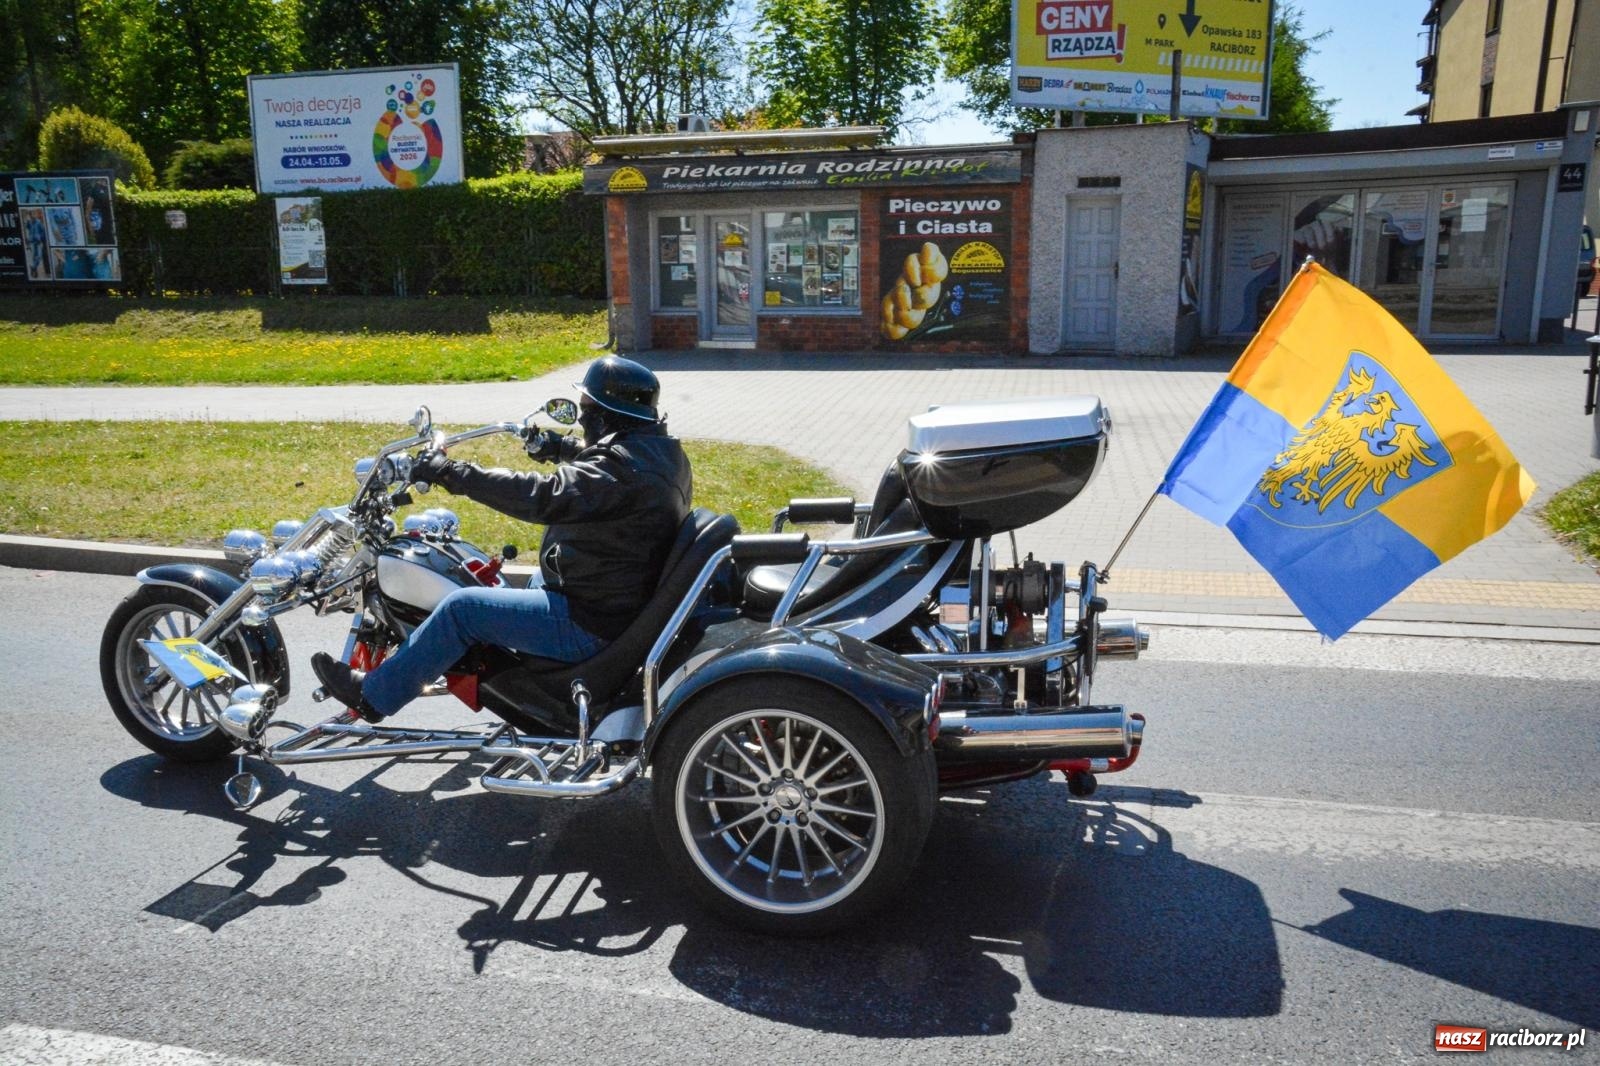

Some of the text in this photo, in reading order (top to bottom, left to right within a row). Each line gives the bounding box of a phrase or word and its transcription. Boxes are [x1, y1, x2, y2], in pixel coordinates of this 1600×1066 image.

[1041, 5, 1109, 30] CENY
[1202, 25, 1262, 39] Opawska 183
[1154, 39, 1175, 48] PARK
[263, 96, 362, 116] Twoja decyzja
[275, 117, 351, 127] NASZA REALIZACJA
[289, 156, 343, 167] 24.04.-13.05.
[662, 162, 806, 178] Piekarnia
[816, 158, 966, 173] Rodzinna
[826, 171, 893, 184] Emilia
[1563, 168, 1582, 179] 44
[889, 199, 1001, 214] Pieczywo
[899, 220, 993, 235] i Ciasta
